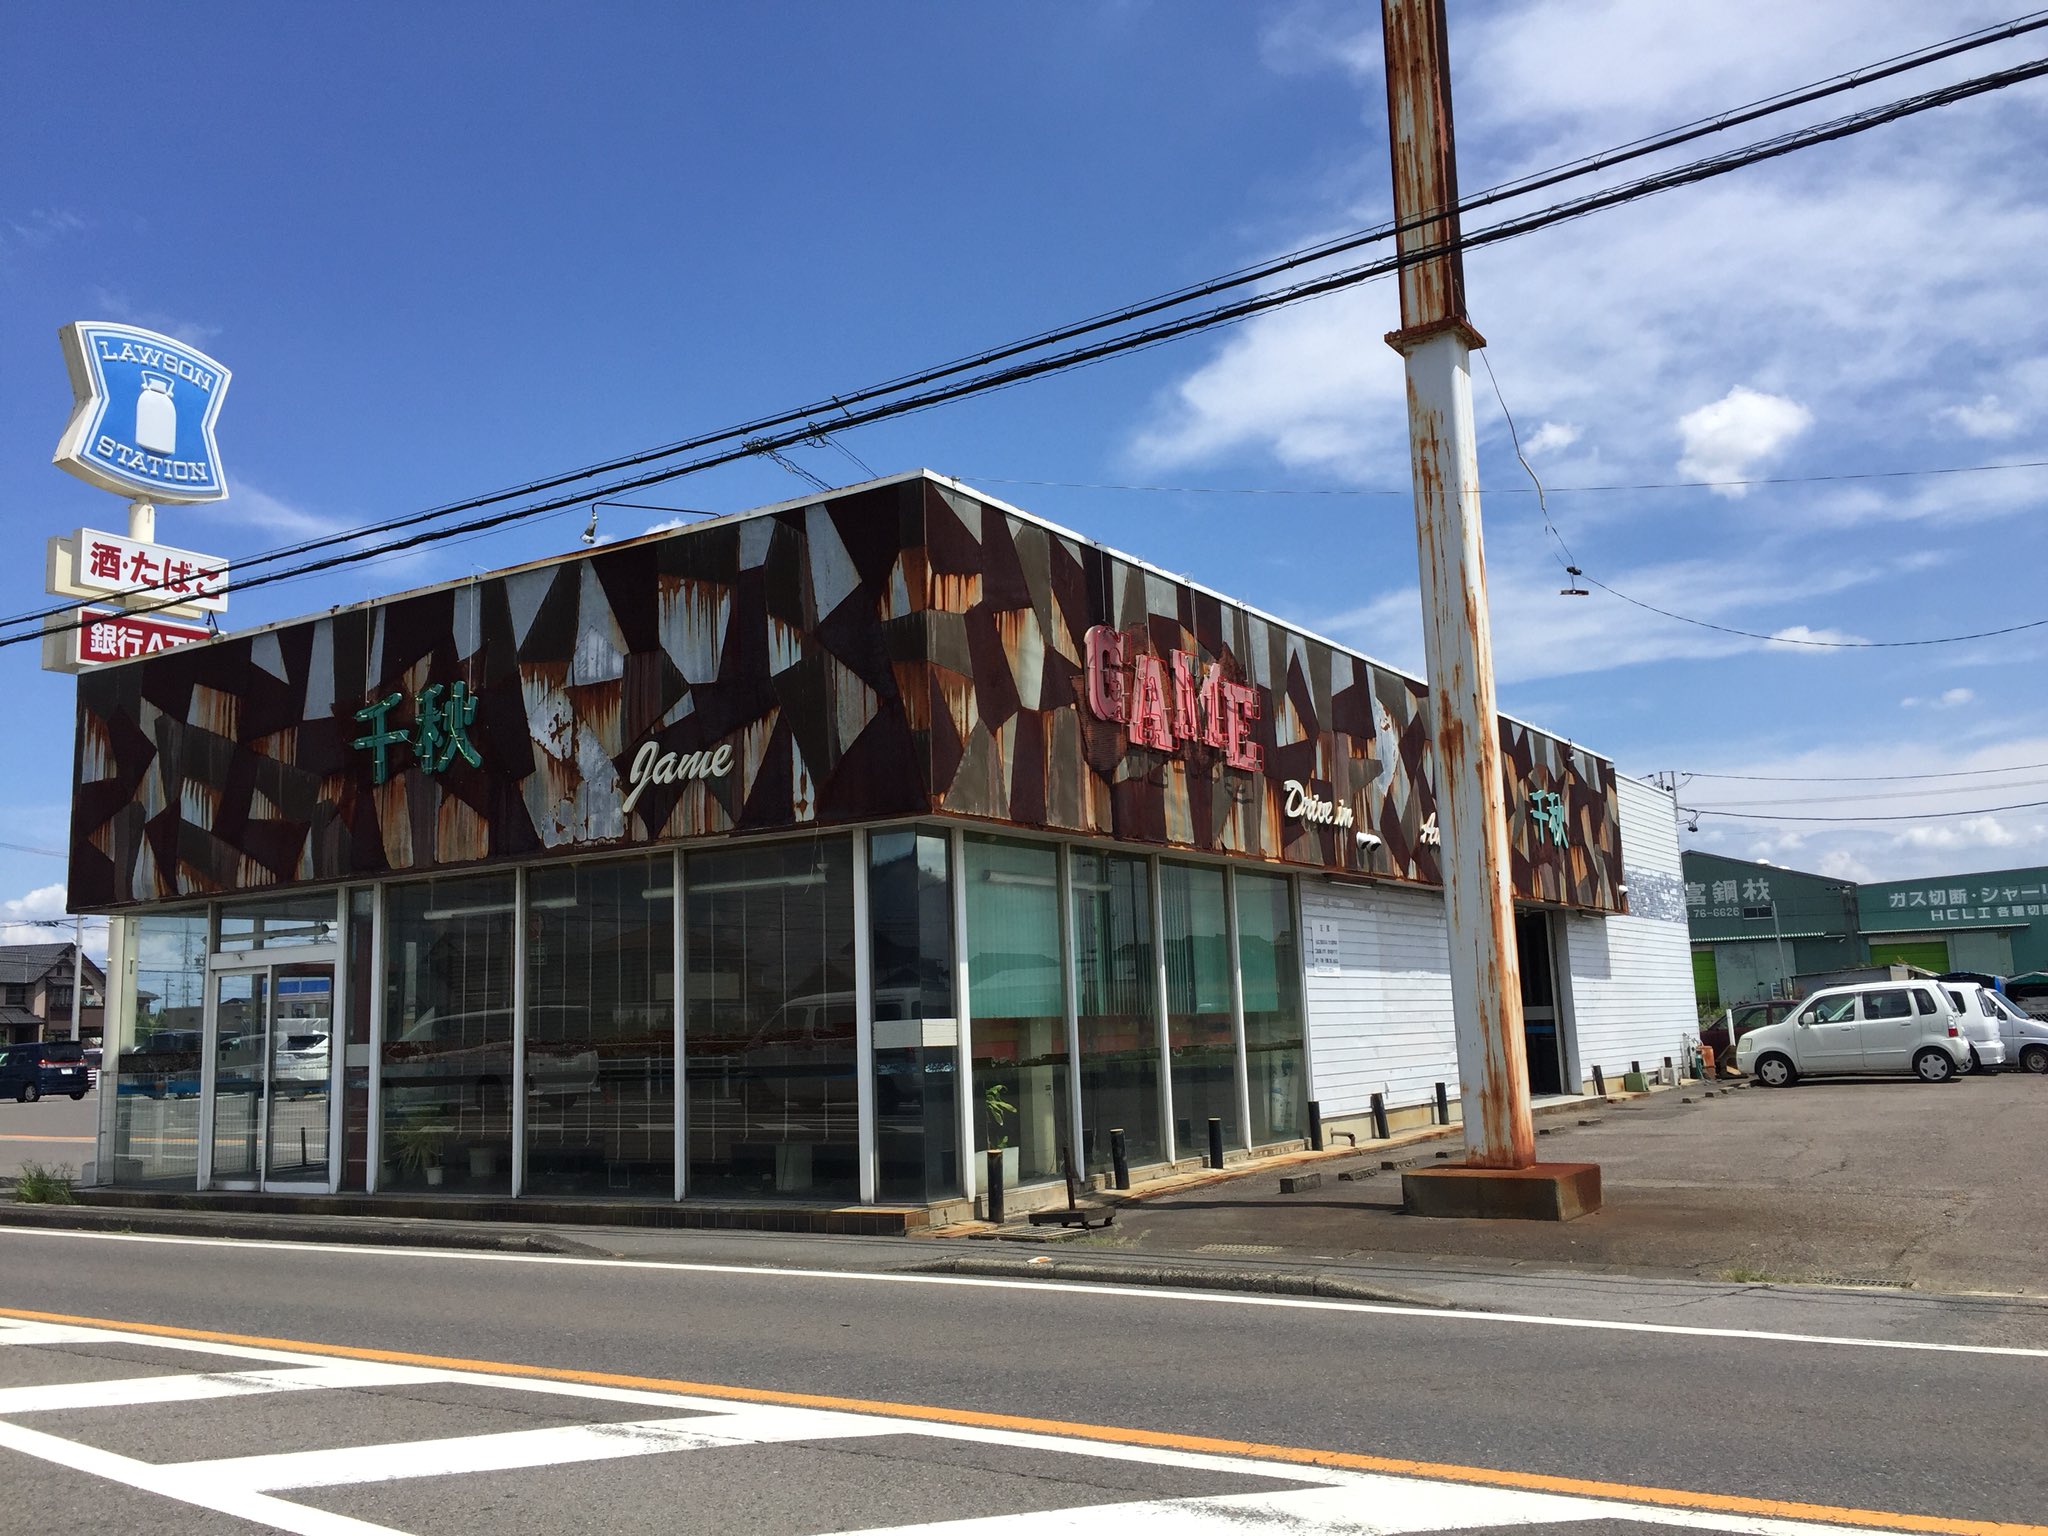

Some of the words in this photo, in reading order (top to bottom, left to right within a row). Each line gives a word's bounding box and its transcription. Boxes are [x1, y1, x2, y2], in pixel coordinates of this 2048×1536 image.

[99, 341, 213, 393] LAWSON
[96, 435, 208, 482] STATION
[90, 622, 199, 658] 銀行AT
[1083, 624, 1264, 772] GAME
[351, 680, 482, 784] 千秋
[1284, 780, 1333, 825] Drive
[1333, 799, 1354, 828] in
[1529, 789, 1569, 849] 千秋
